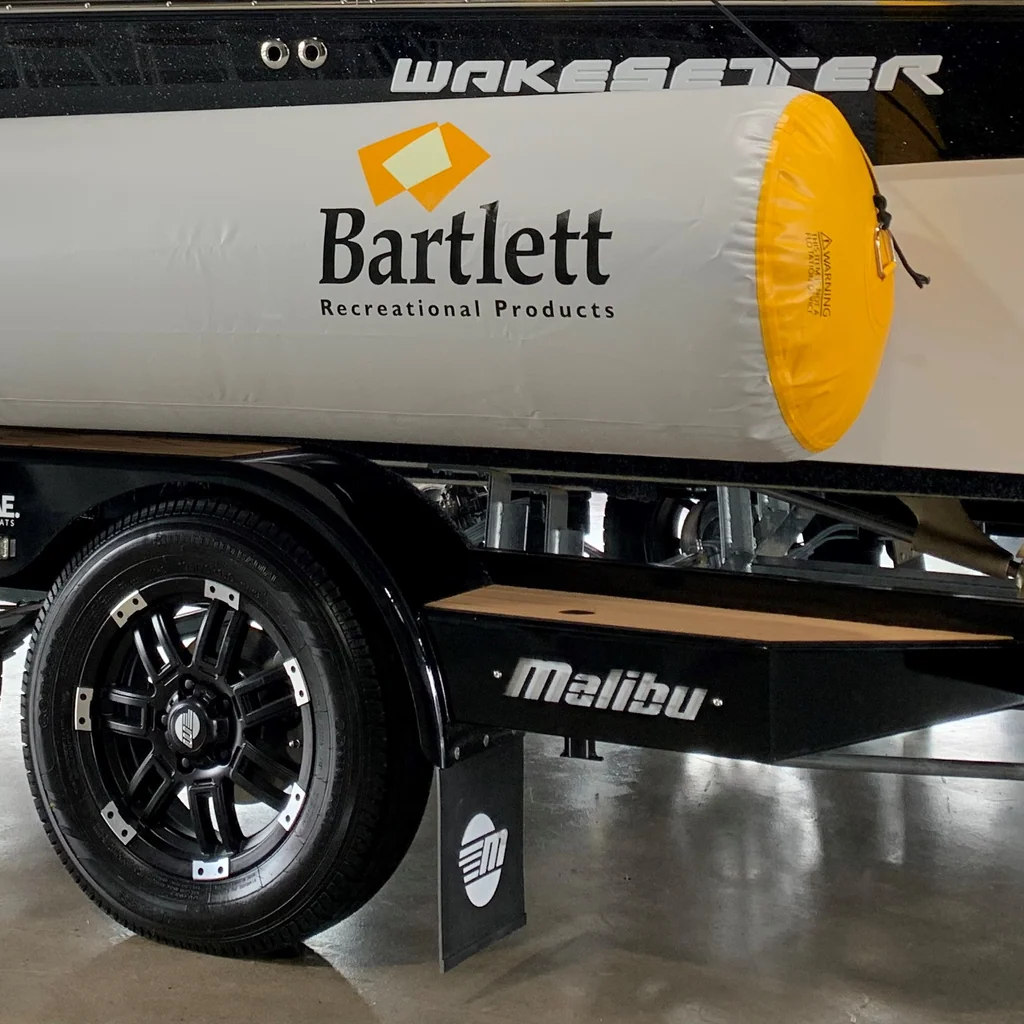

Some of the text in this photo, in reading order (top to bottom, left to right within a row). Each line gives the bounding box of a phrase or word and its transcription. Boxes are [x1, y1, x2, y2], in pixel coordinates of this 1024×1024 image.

[390, 54, 944, 96] WAKESETTER
[319, 200, 613, 285] Bartlett
[320, 299, 615, 318] Recreational Products
[823, 251, 832, 318] WARNING
[502, 657, 708, 721] Malibu
